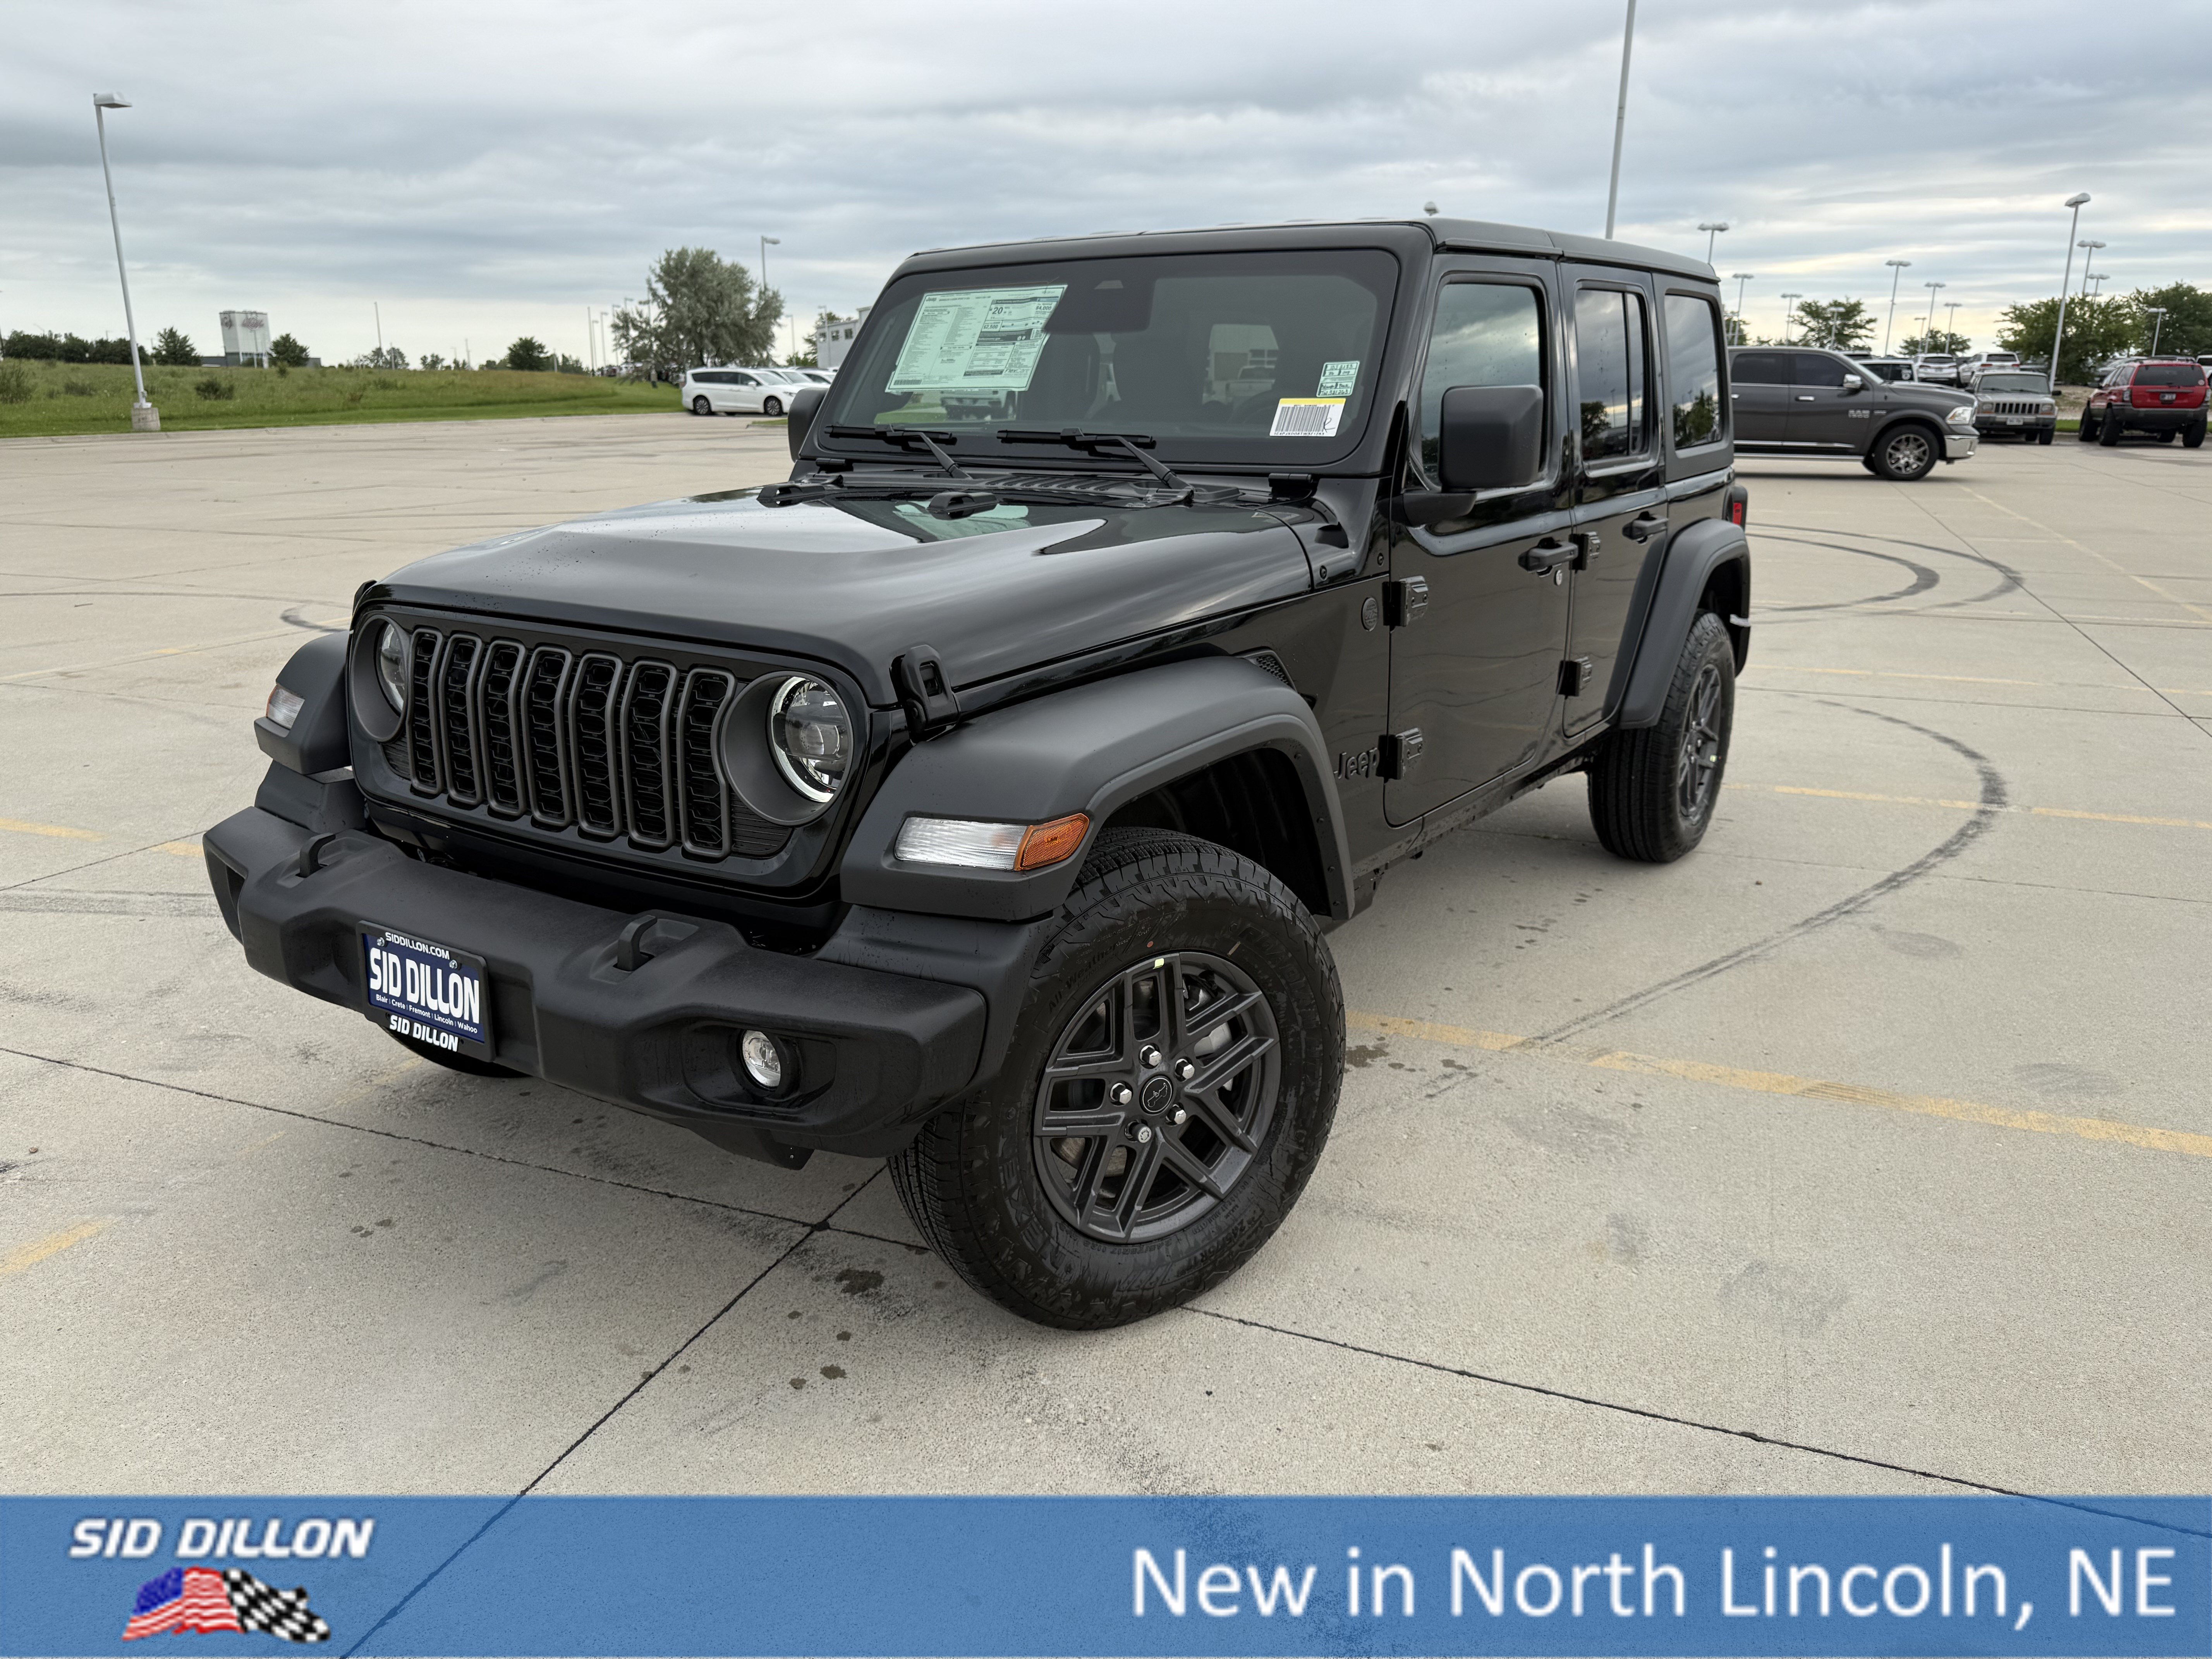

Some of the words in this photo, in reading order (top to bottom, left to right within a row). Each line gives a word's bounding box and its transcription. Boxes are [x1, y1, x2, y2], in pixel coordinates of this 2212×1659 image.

[1333, 747, 1380, 780] Jeep
[385, 932, 450, 960] SIDDILLON.COM
[370, 947, 402, 998] SID
[405, 958, 480, 1024] DILLON
[376, 994, 388, 1003] Blair
[392, 999, 405, 1010] Crete
[409, 1005, 431, 1018] Fremont
[434, 1013, 454, 1026] Lincoln
[457, 1021, 477, 1034] Wahoo
[390, 1015, 410, 1035] SID
[412, 1022, 459, 1052] DILLON
